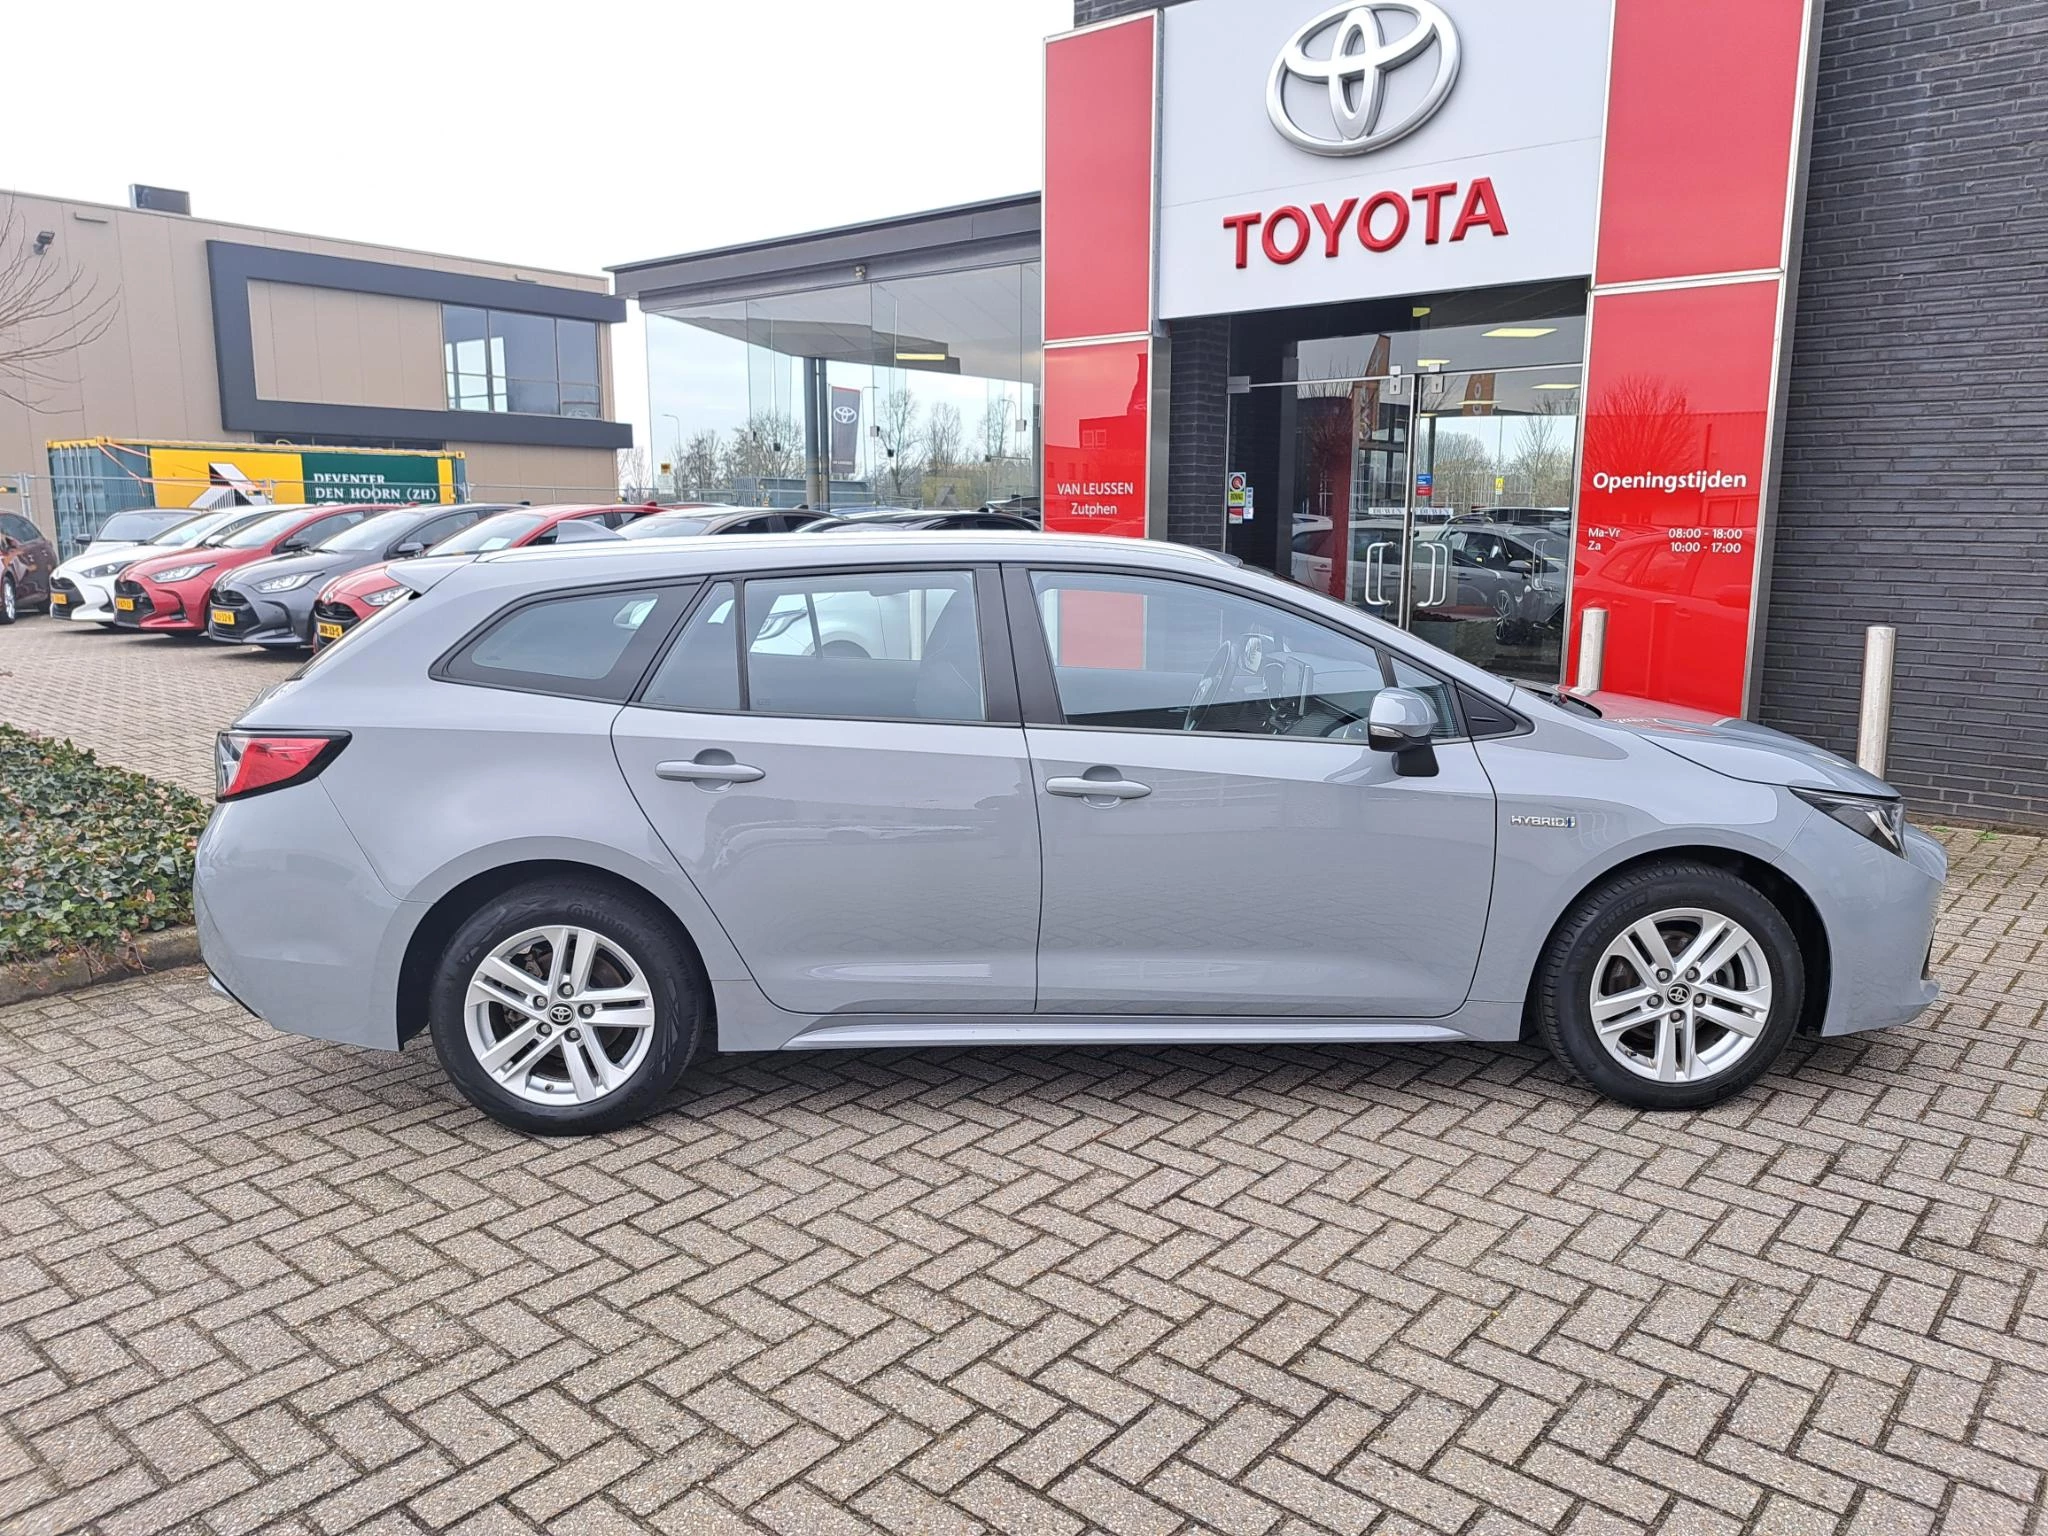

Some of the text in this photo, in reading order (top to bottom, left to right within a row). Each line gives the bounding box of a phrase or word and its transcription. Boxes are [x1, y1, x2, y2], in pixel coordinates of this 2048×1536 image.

[1223, 176, 1509, 269] TOYOTA
[313, 473, 385, 484] DEVENTER
[1593, 470, 1747, 493] Openingstijden
[315, 487, 437, 502] DEN HOORN (ZH)
[1057, 482, 1134, 495] VAN LEUSSEN
[1071, 502, 1118, 517] Zutphen
[1588, 528, 1621, 538] Ma-Vr
[1668, 528, 1701, 539] 08:00
[1713, 529, 1743, 540] 18:00
[1587, 541, 1601, 551] Za
[1671, 542, 1701, 552] 10:00
[1711, 543, 1742, 553] 17:00
[1511, 815, 1567, 828] HYBRID
